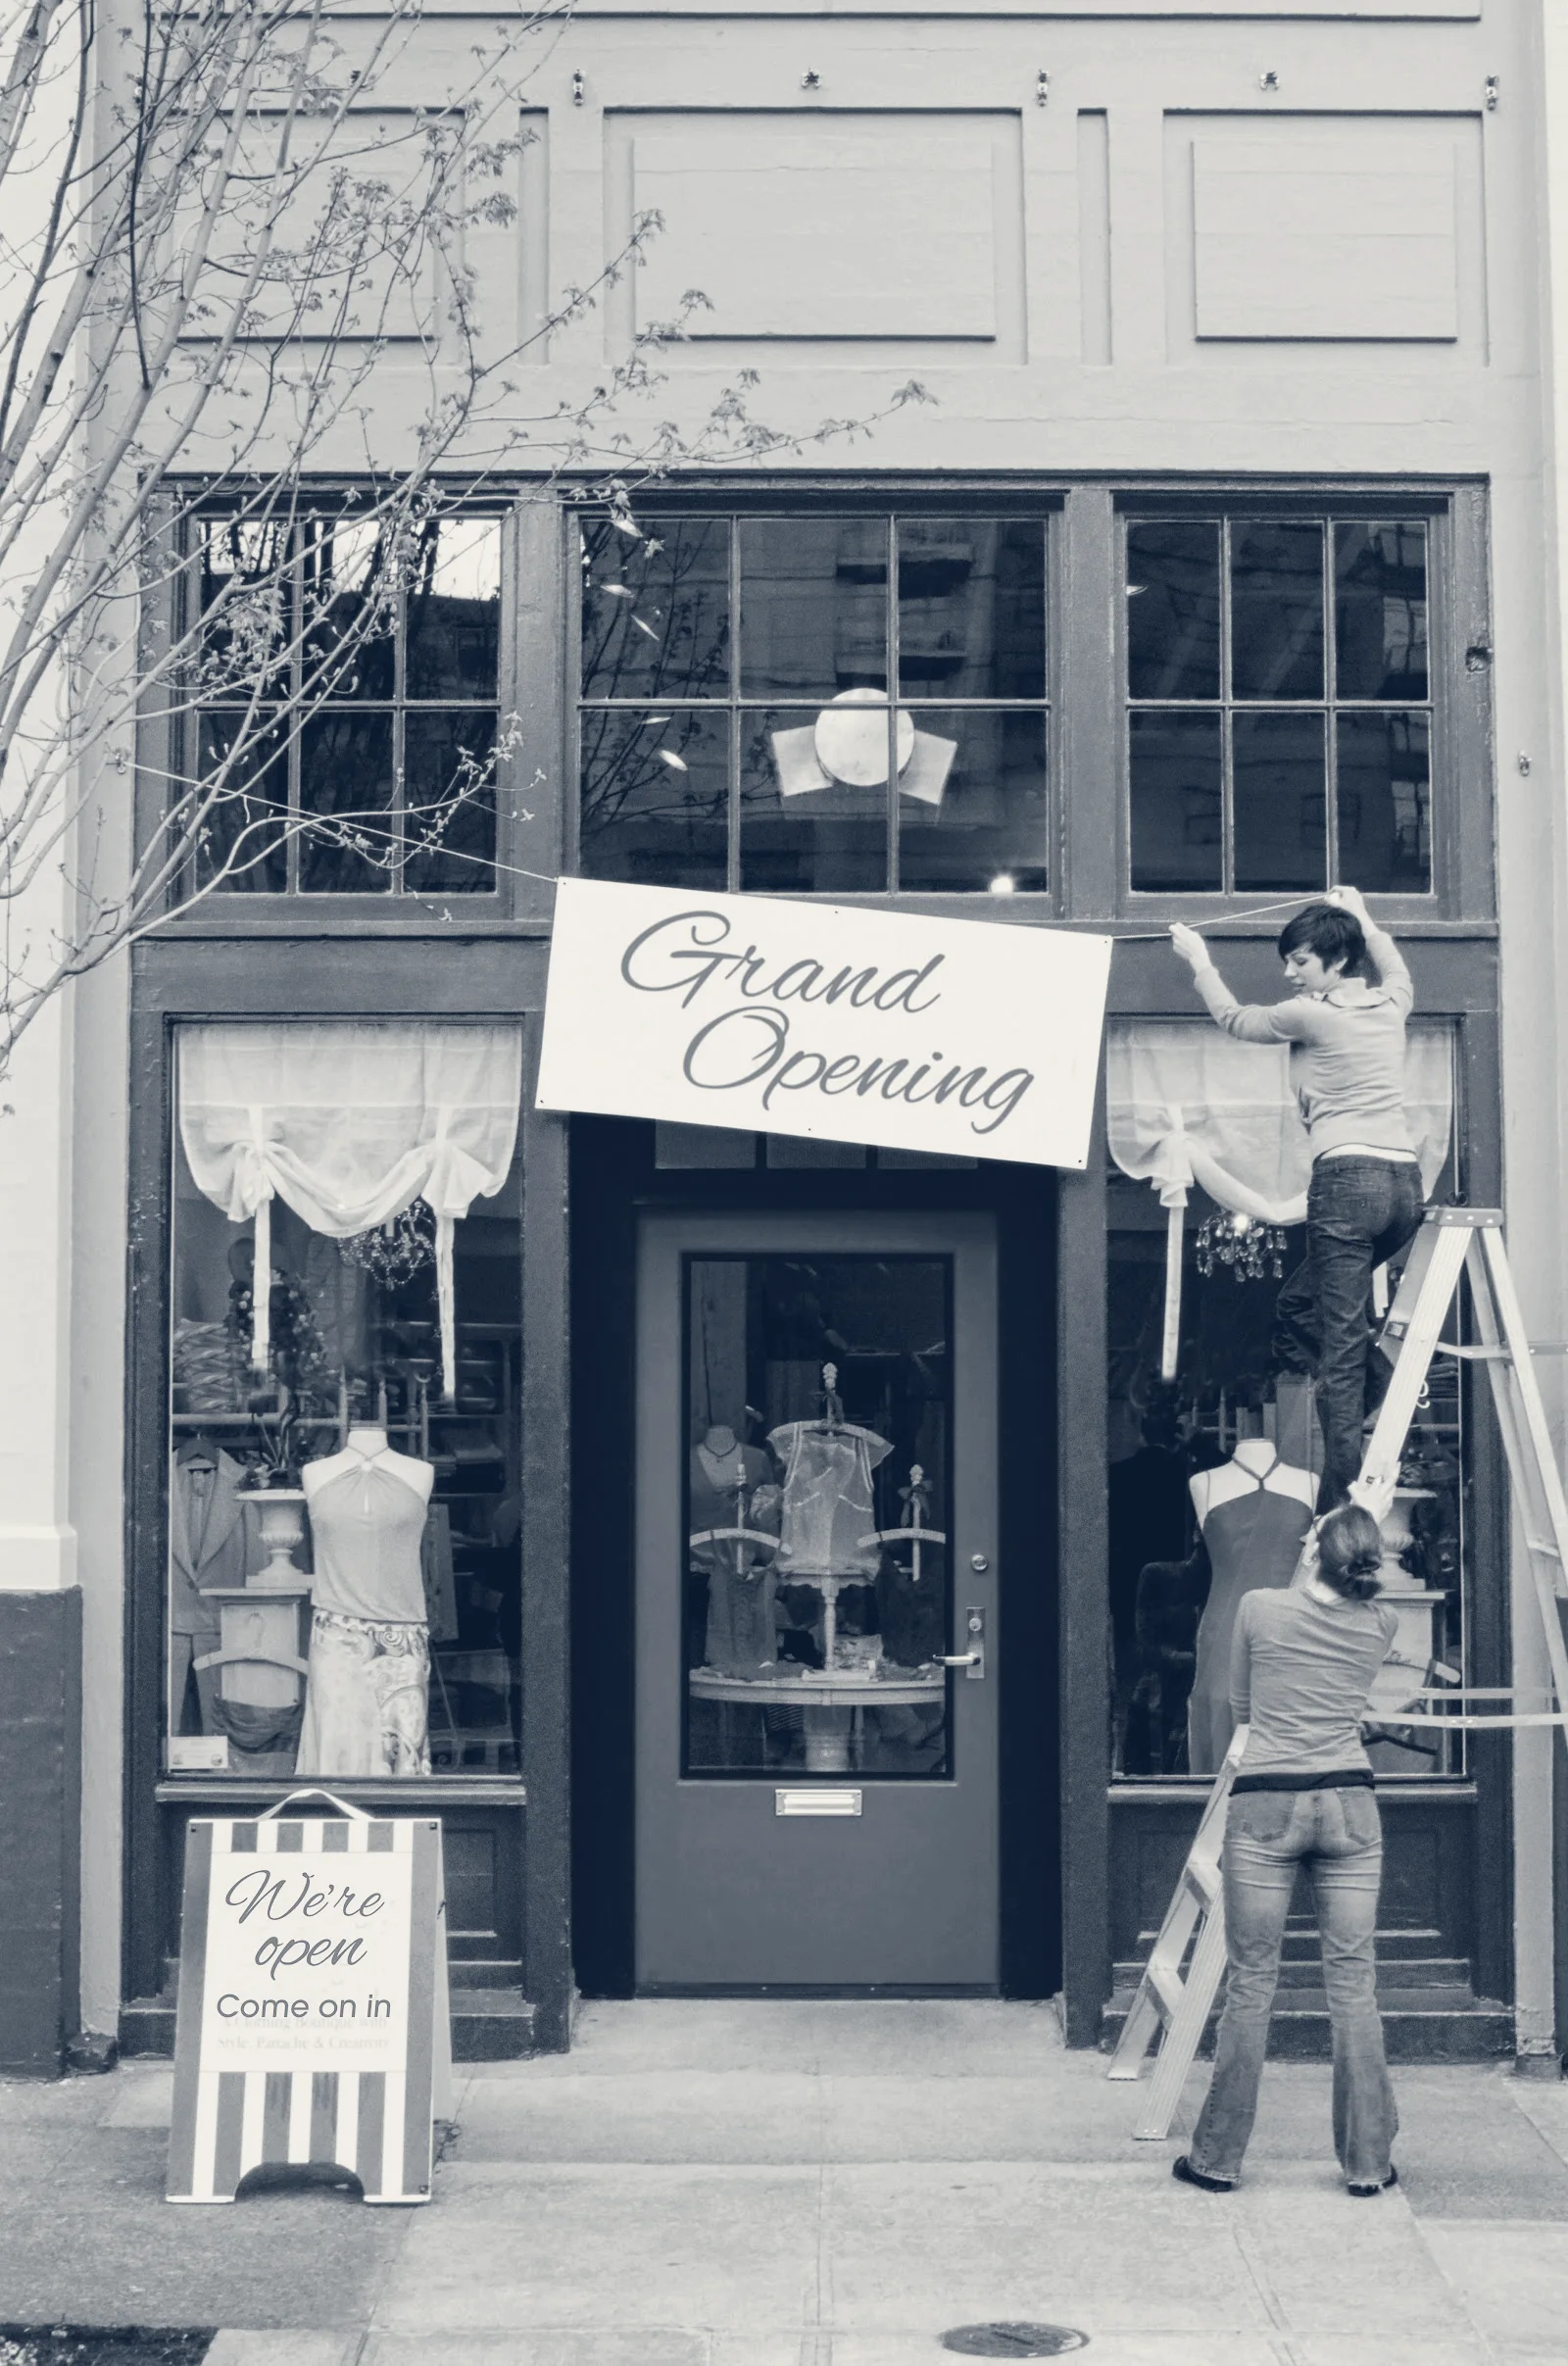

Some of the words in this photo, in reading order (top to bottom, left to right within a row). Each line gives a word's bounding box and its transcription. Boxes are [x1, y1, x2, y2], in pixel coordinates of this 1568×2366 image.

[620, 910, 946, 1013] Grand
[682, 1005, 1035, 1135] Opening
[224, 1869, 385, 1925] We're
[254, 1936, 368, 1981] open
[217, 1994, 310, 2018] Come
[318, 1998, 357, 2018] on
[367, 1994, 391, 2018] in
